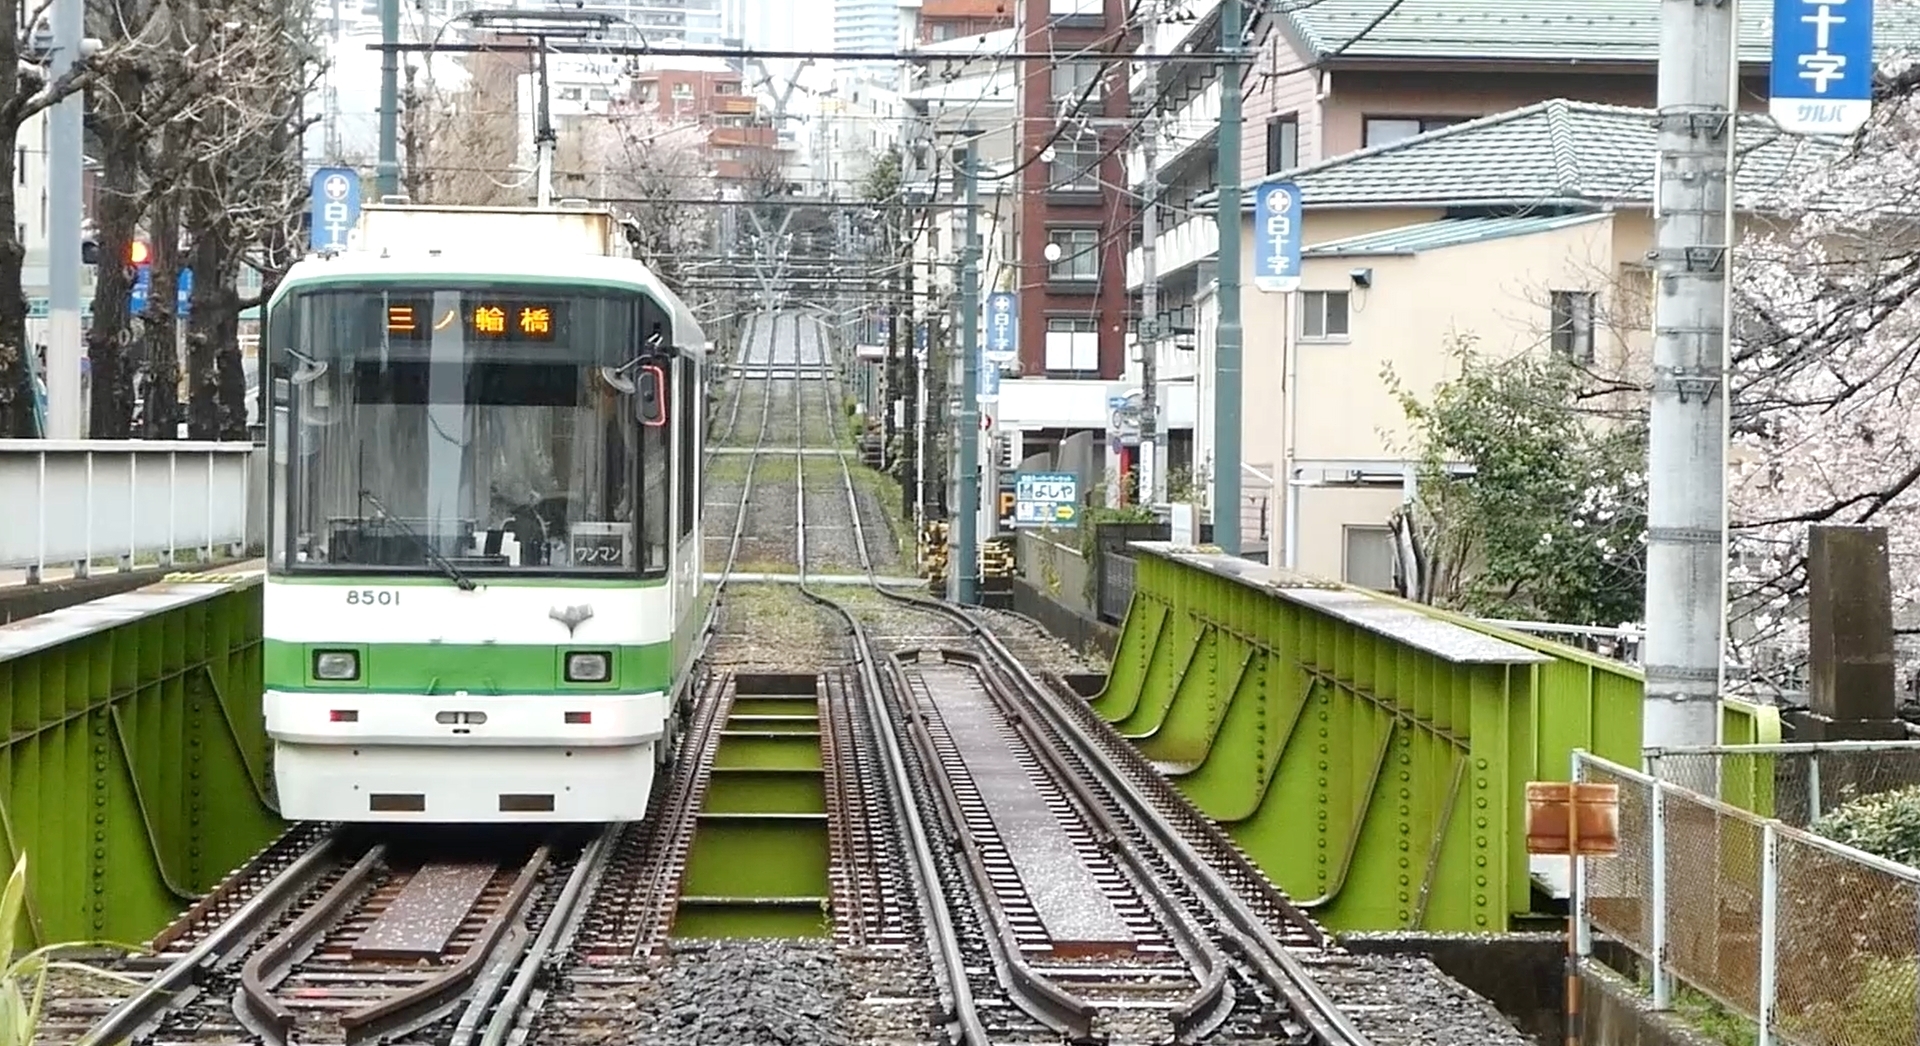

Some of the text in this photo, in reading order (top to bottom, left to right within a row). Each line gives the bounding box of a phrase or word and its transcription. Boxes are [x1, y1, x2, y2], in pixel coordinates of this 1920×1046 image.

[1798, 0, 1846, 93] 十字
[1796, 104, 1847, 122] サルバ
[1267, 214, 1290, 275] 白十字
[386, 306, 549, 332] 三ノ輪橋
[1035, 484, 1073, 499] よしや
[1000, 492, 1016, 515] P
[575, 547, 621, 561] ワンマン
[346, 589, 399, 605] 8501
